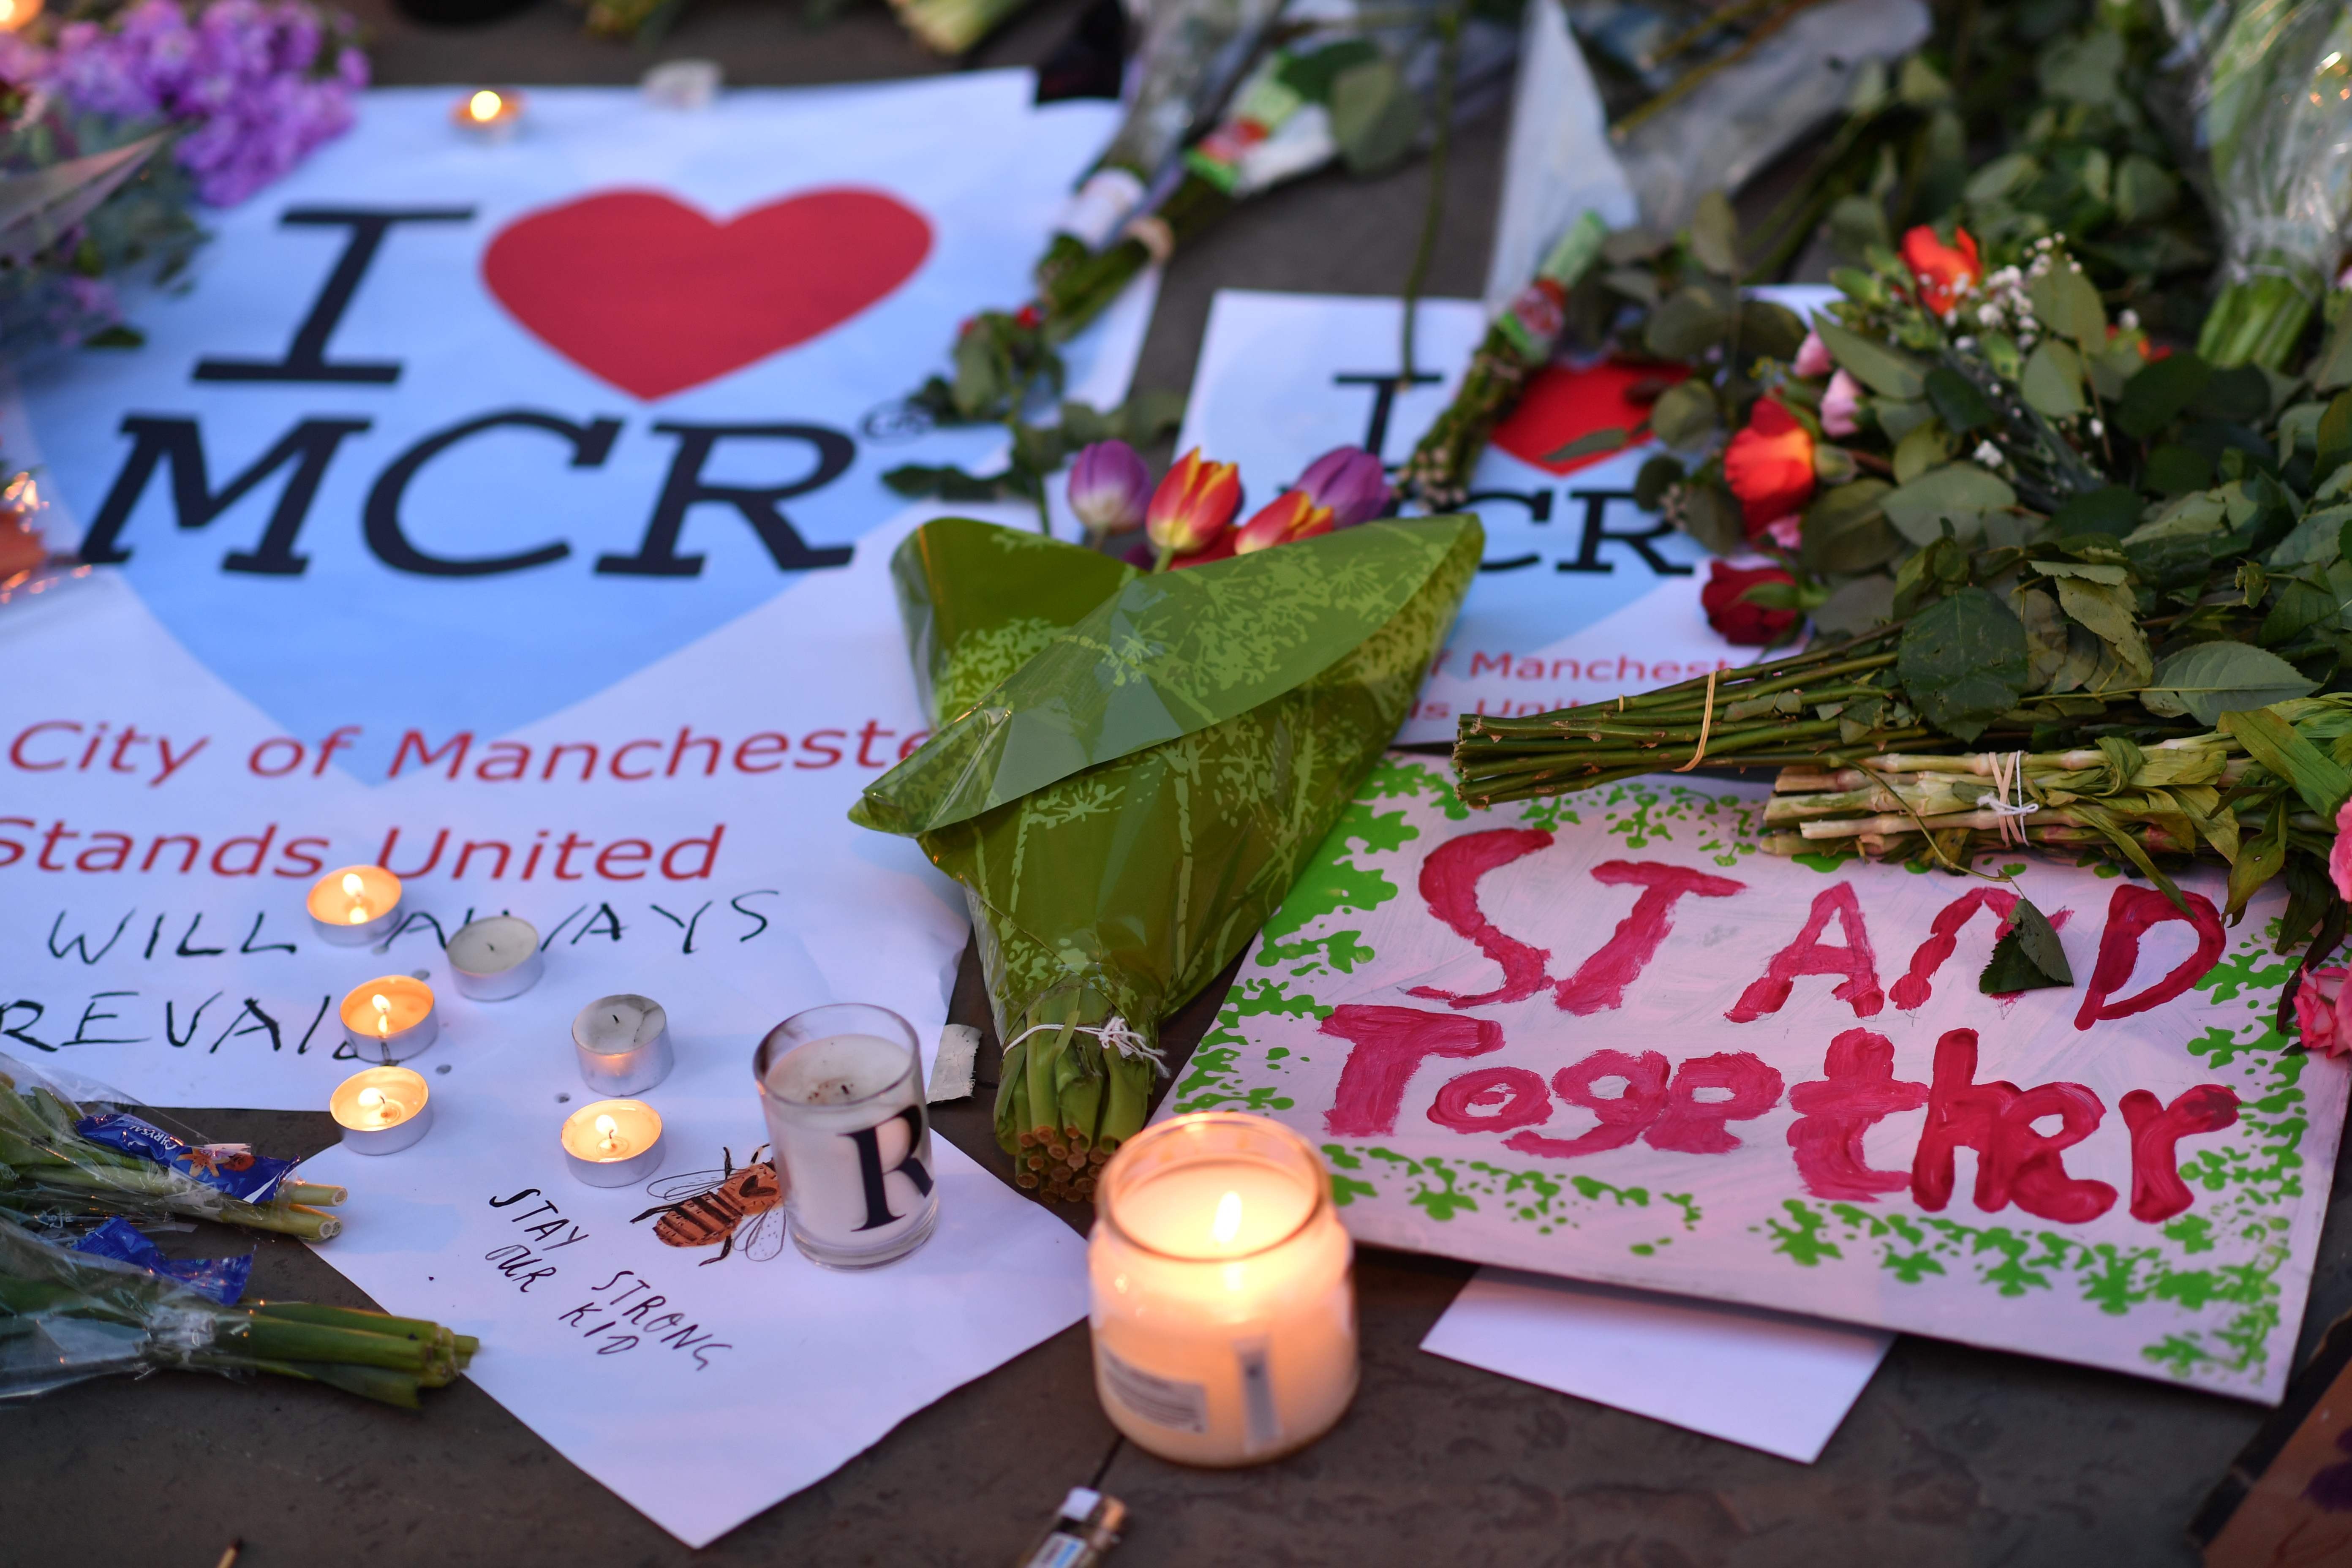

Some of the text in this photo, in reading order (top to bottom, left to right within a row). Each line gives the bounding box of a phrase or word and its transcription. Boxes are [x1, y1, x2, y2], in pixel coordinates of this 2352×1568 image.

[192, 204, 477, 383] I
[78, 406, 858, 578] MCR
[8, 719, 210, 788] City
[246, 725, 363, 779] of
[376, 824, 726, 882] United
[48, 907, 297, 965] WILL
[836, 1104, 934, 1232] R
[1318, 1003, 2241, 1224] Together
[485, 1244, 639, 1355] OUR KID
[489, 1188, 733, 1372] STAY STRONG
